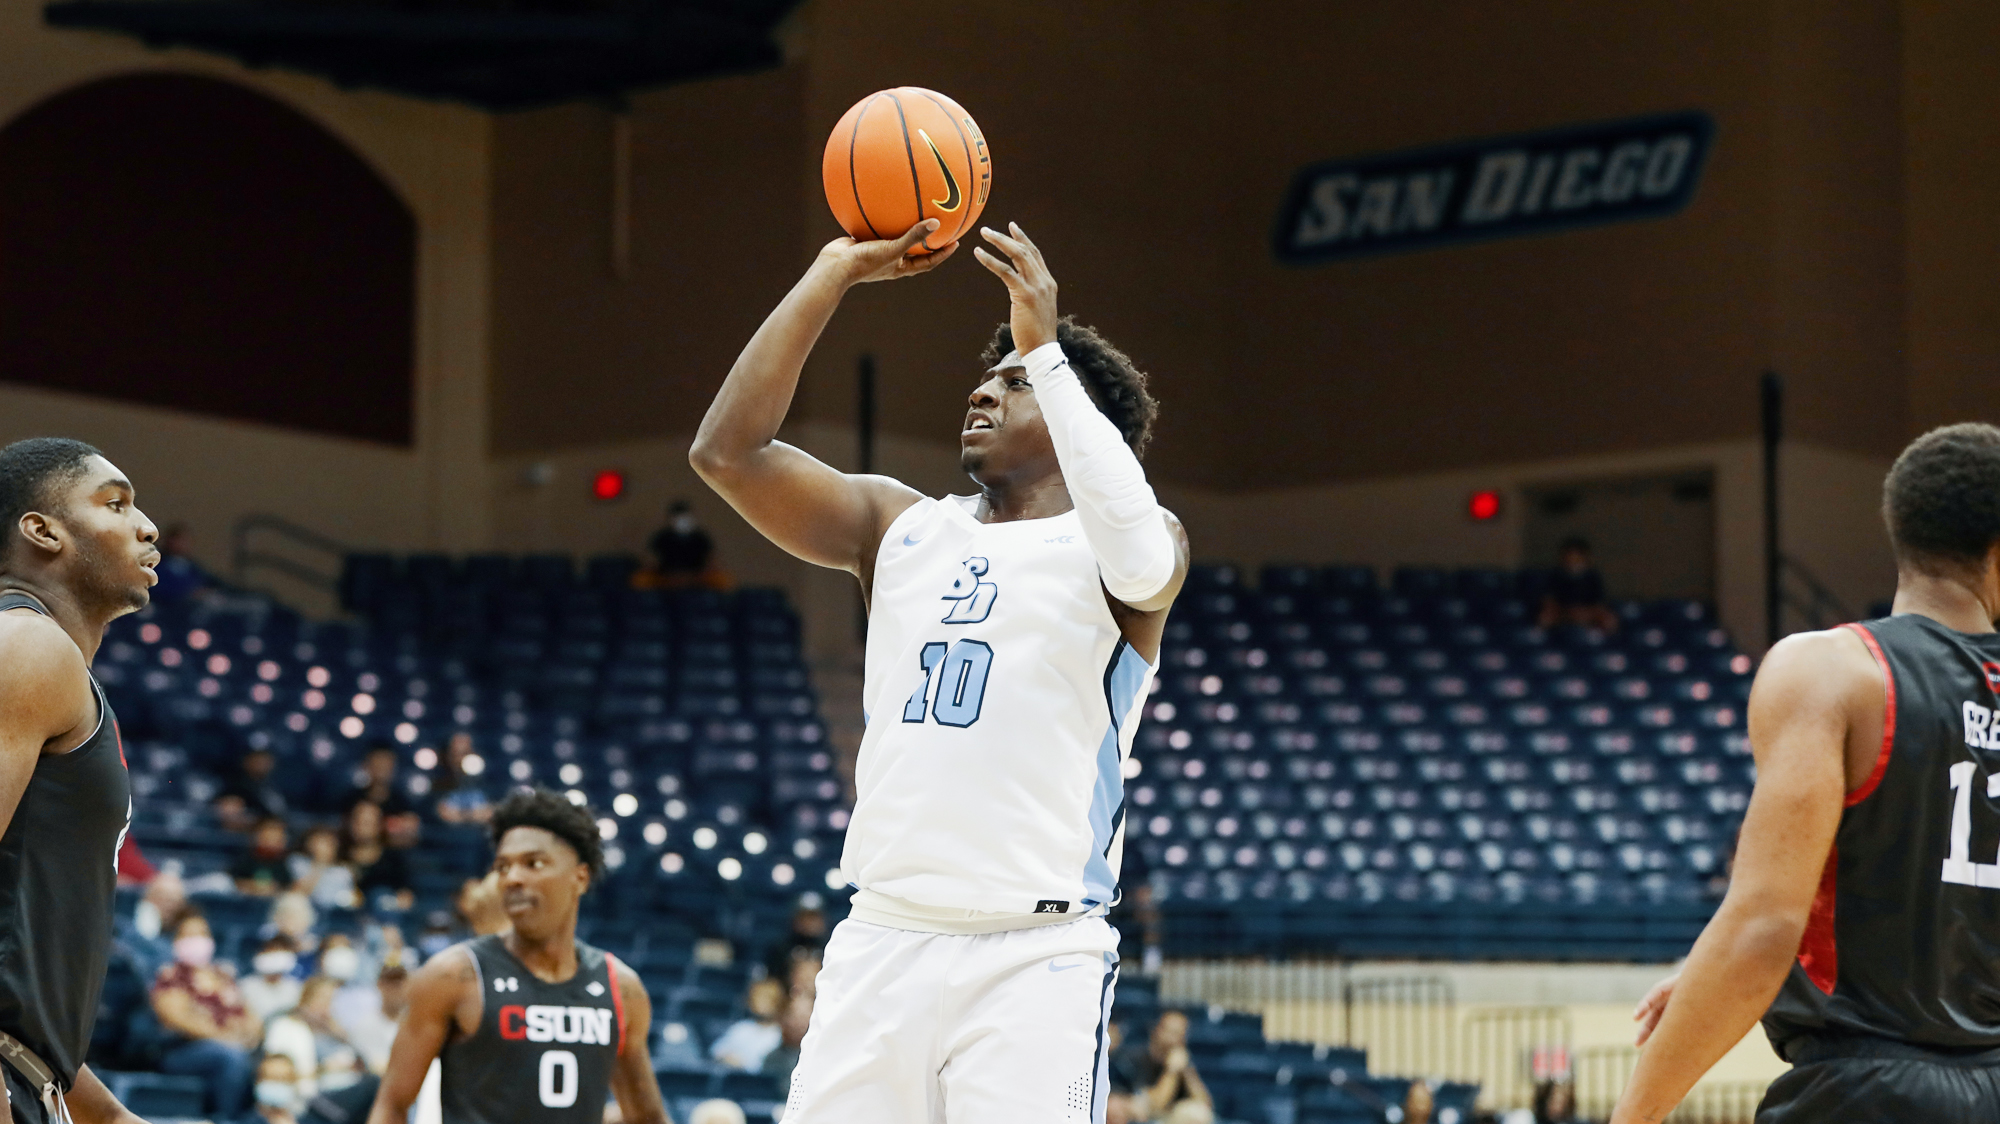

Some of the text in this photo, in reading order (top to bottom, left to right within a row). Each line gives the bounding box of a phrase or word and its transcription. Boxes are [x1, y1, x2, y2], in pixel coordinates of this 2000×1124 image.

[962, 116, 992, 205] ELITE
[1295, 135, 1692, 248] SAN DIEGO
[941, 556, 998, 625] SD
[902, 638, 994, 728] 10
[1042, 903, 1060, 913] XL
[498, 1004, 613, 1046] CSUN
[538, 1050, 579, 1108] 0
